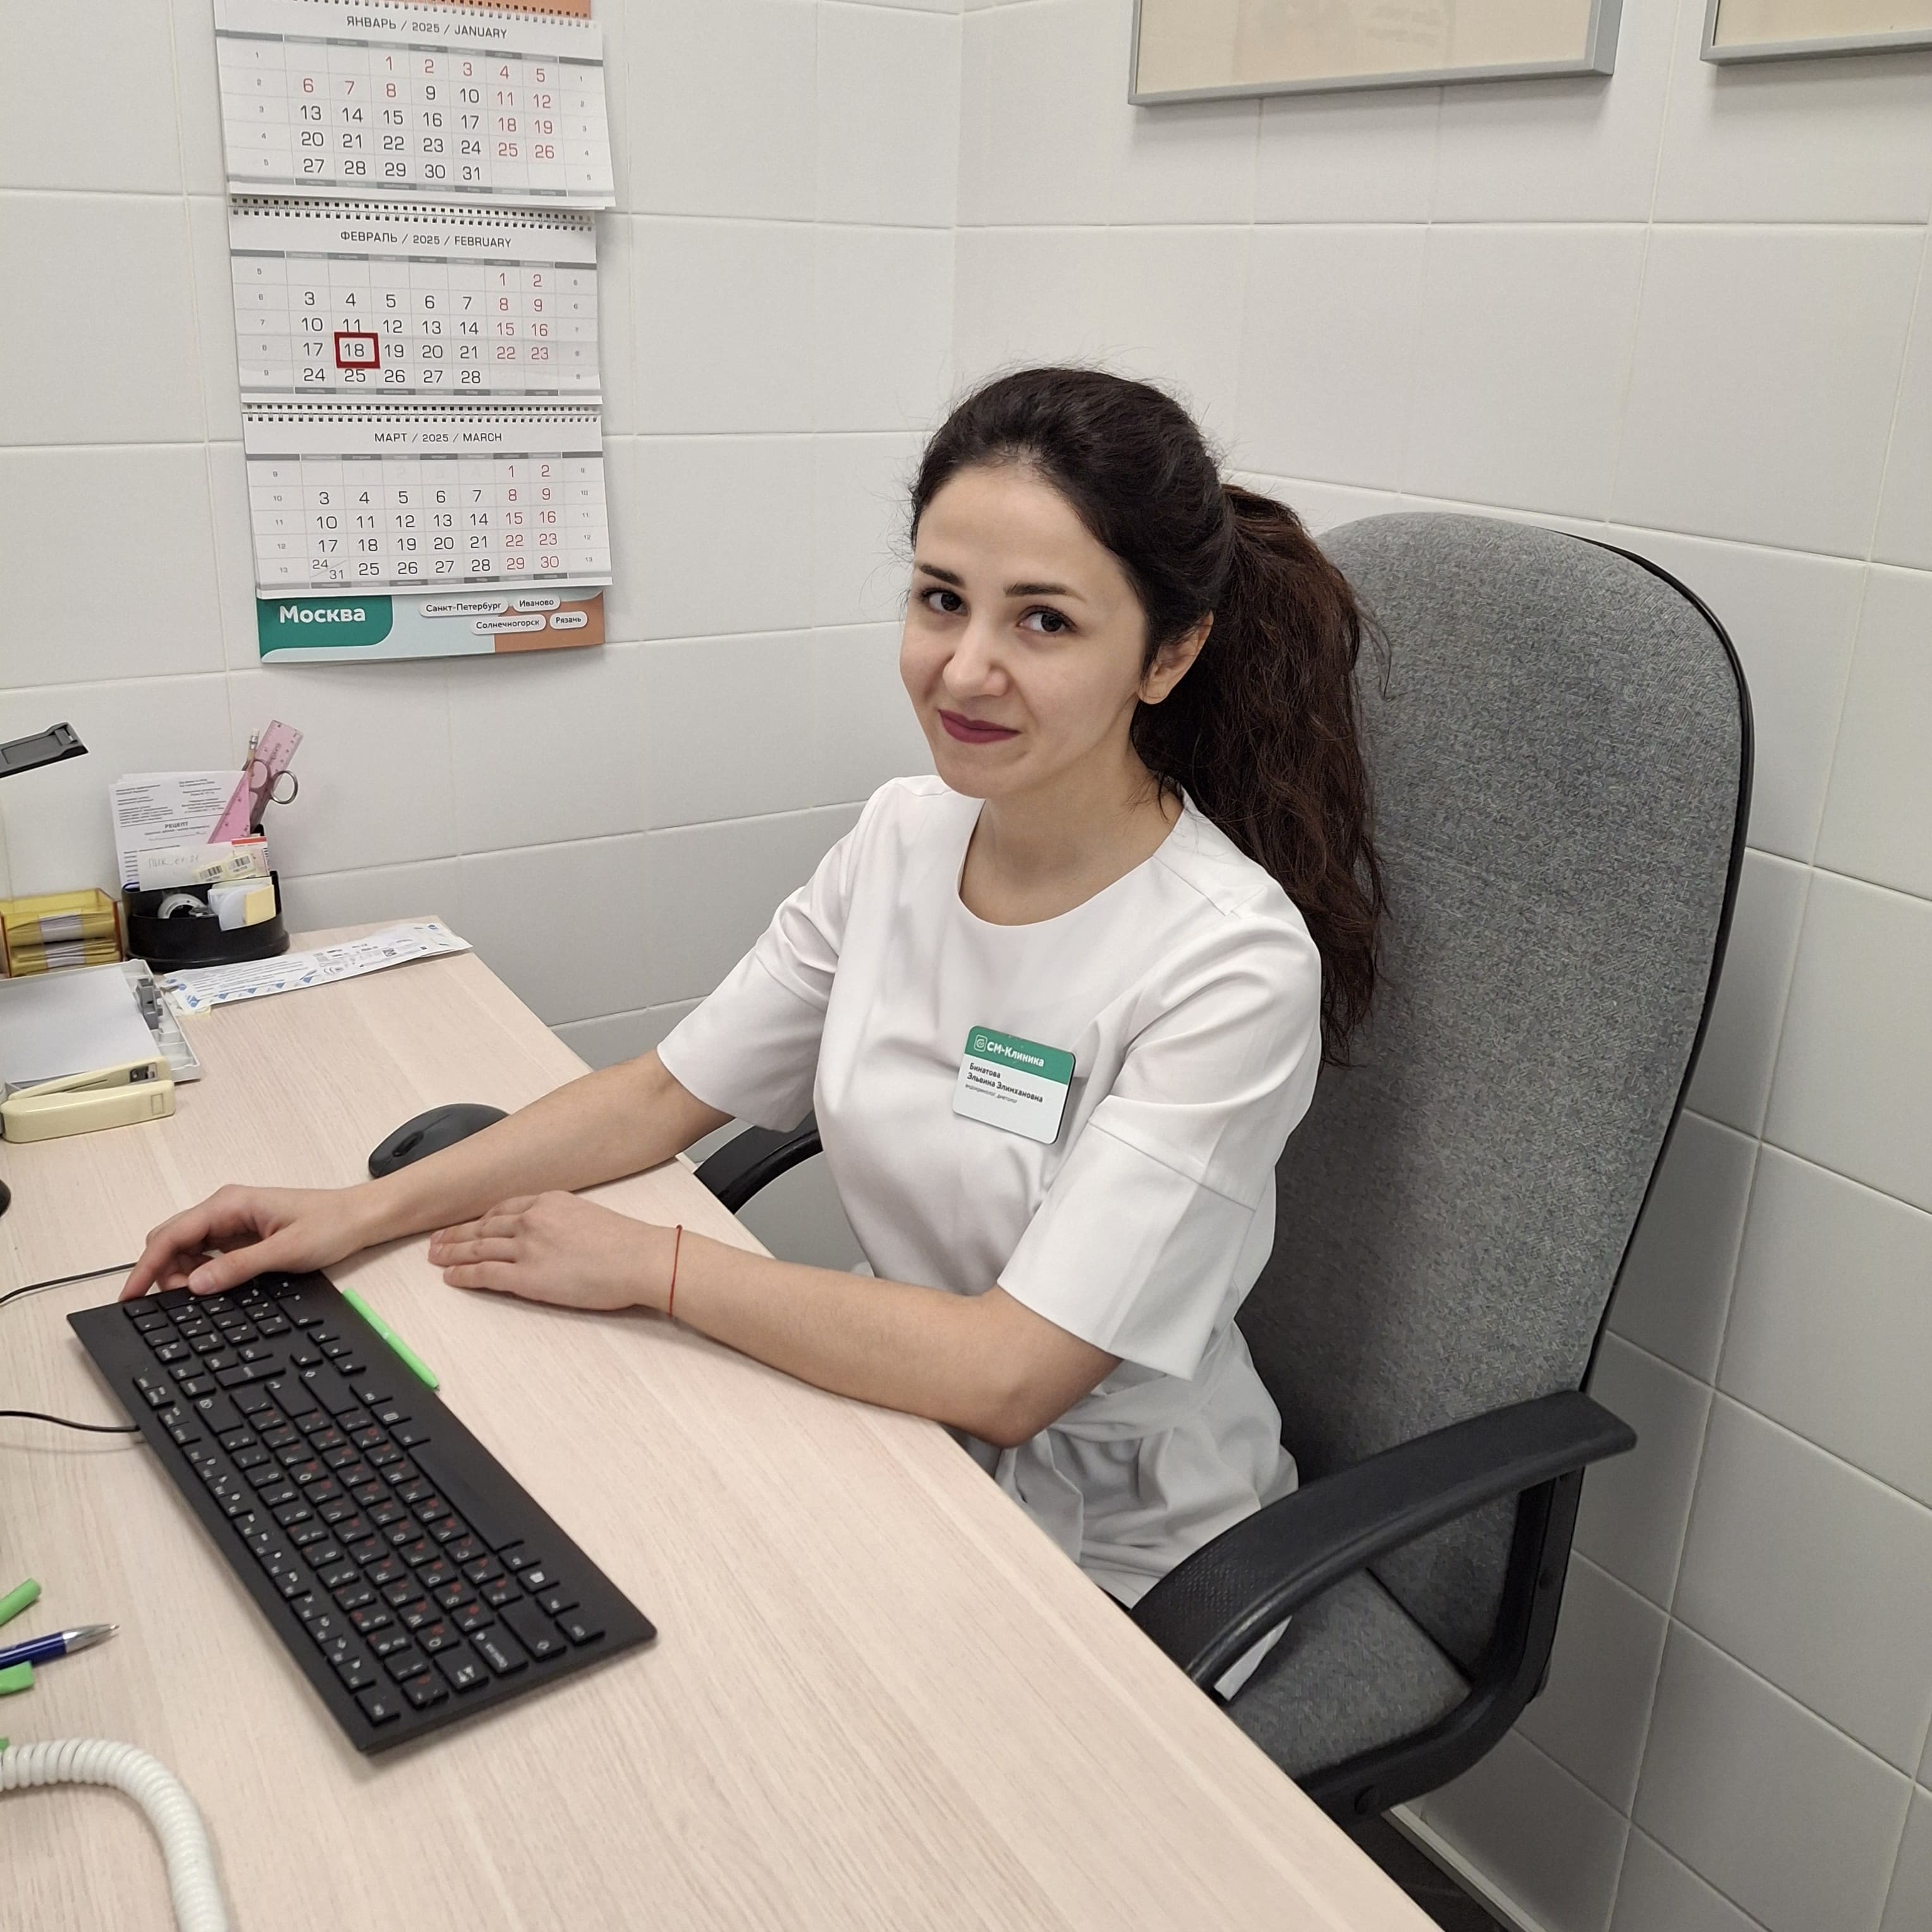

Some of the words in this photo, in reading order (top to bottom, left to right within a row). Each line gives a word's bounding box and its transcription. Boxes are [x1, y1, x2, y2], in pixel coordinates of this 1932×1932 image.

[346, 15, 396, 30] ЯНВАРЬ
[412, 21, 440, 32] 2025
[455, 25, 507, 39] JANUARY
[386, 56, 393, 71] 1
[424, 59, 434, 74] 2
[463, 61, 472, 76] 3
[499, 65, 510, 80] 4
[536, 68, 546, 83] 5
[303, 78, 314, 93] 6
[345, 80, 355, 95] 7
[386, 83, 396, 98] 8
[425, 85, 436, 101] 9
[460, 88, 479, 104] 10
[497, 90, 513, 106] 11
[533, 94, 551, 109] 12
[300, 104, 322, 121] 13
[341, 107, 364, 123] 14
[382, 109, 403, 125] 15
[422, 111, 443, 128] 16
[461, 114, 479, 130] 17
[498, 117, 517, 132] 18
[534, 119, 553, 135] 19
[301, 131, 324, 147] 20
[342, 133, 362, 149] 21
[383, 135, 405, 151] 22
[423, 137, 444, 153] 23
[461, 140, 481, 156] 24
[498, 142, 518, 157] 25
[535, 144, 554, 159] 26
[303, 158, 324, 174] 27
[344, 160, 366, 176] 28
[384, 162, 407, 177] 29
[424, 164, 446, 179] 30
[462, 166, 480, 181] 31
[340, 231, 398, 243] ФЕВРАЛЬ
[413, 235, 440, 245] 2025
[455, 235, 511, 248] FEBRUARY
[499, 272, 505, 286] 1
[533, 274, 542, 288] 2
[304, 291, 315, 306] 3
[345, 293, 357, 307] 4
[386, 293, 396, 309] 5
[424, 295, 435, 309] 6
[462, 296, 472, 310] 7
[499, 297, 509, 311] 8
[534, 298, 542, 312] 9
[301, 317, 323, 332] 10
[343, 319, 360, 333] 11
[382, 319, 403, 334] 12
[422, 320, 441, 334] 13
[460, 321, 479, 335] 14
[496, 322, 515, 336] 15
[531, 323, 548, 337] 16
[303, 342, 324, 357] 17
[344, 343, 365, 357] 18
[384, 344, 404, 358] 19
[422, 345, 443, 359] 20
[460, 345, 477, 360] 21
[496, 346, 516, 360] 22
[531, 346, 549, 360] 23
[303, 367, 326, 382] 24
[345, 369, 365, 382] 25
[384, 369, 405, 383] 26
[423, 369, 443, 384] 27
[461, 370, 481, 384] 28
[374, 433, 408, 442] МАРТ
[422, 434, 449, 442] 2025
[463, 433, 502, 442] MARCH
[508, 465, 514, 478] 1
[541, 464, 551, 477] 2
[319, 491, 329, 505] 3
[358, 491, 370, 504] 4
[398, 491, 408, 504] 5
[436, 490, 446, 503] 6
[472, 489, 482, 503] 7
[508, 489, 517, 501] 8
[542, 487, 551, 501] 9
[316, 516, 338, 530] 10
[356, 515, 374, 529] 11
[395, 515, 416, 528] 12
[433, 513, 453, 527] 13
[470, 513, 489, 526] 14
[505, 511, 523, 525] 15
[539, 510, 556, 523] 16
[318, 539, 338, 553] 17
[358, 539, 378, 552] 18
[397, 537, 417, 551] 19
[434, 537, 454, 550] 20
[470, 535, 487, 549] 21
[505, 534, 524, 547] 22
[539, 532, 558, 546] 23
[312, 559, 329, 569] 24
[329, 570, 343, 580] 31
[358, 562, 380, 576] 25
[397, 561, 418, 575] 26
[435, 560, 455, 573] 27
[471, 558, 491, 572] 28
[506, 557, 525, 570] 29
[541, 556, 559, 568] 30
[425, 602, 501, 612] Санкт-Петербург
[519, 599, 554, 608] Иваново
[279, 605, 365, 623] Москва
[476, 620, 540, 629] Солнечногорск
[164, 821, 188, 829] РЕЦЕПТ
[987, 1041, 1045, 1067] СМ-Клиника
[967, 1072, 996, 1087] Эльвина
